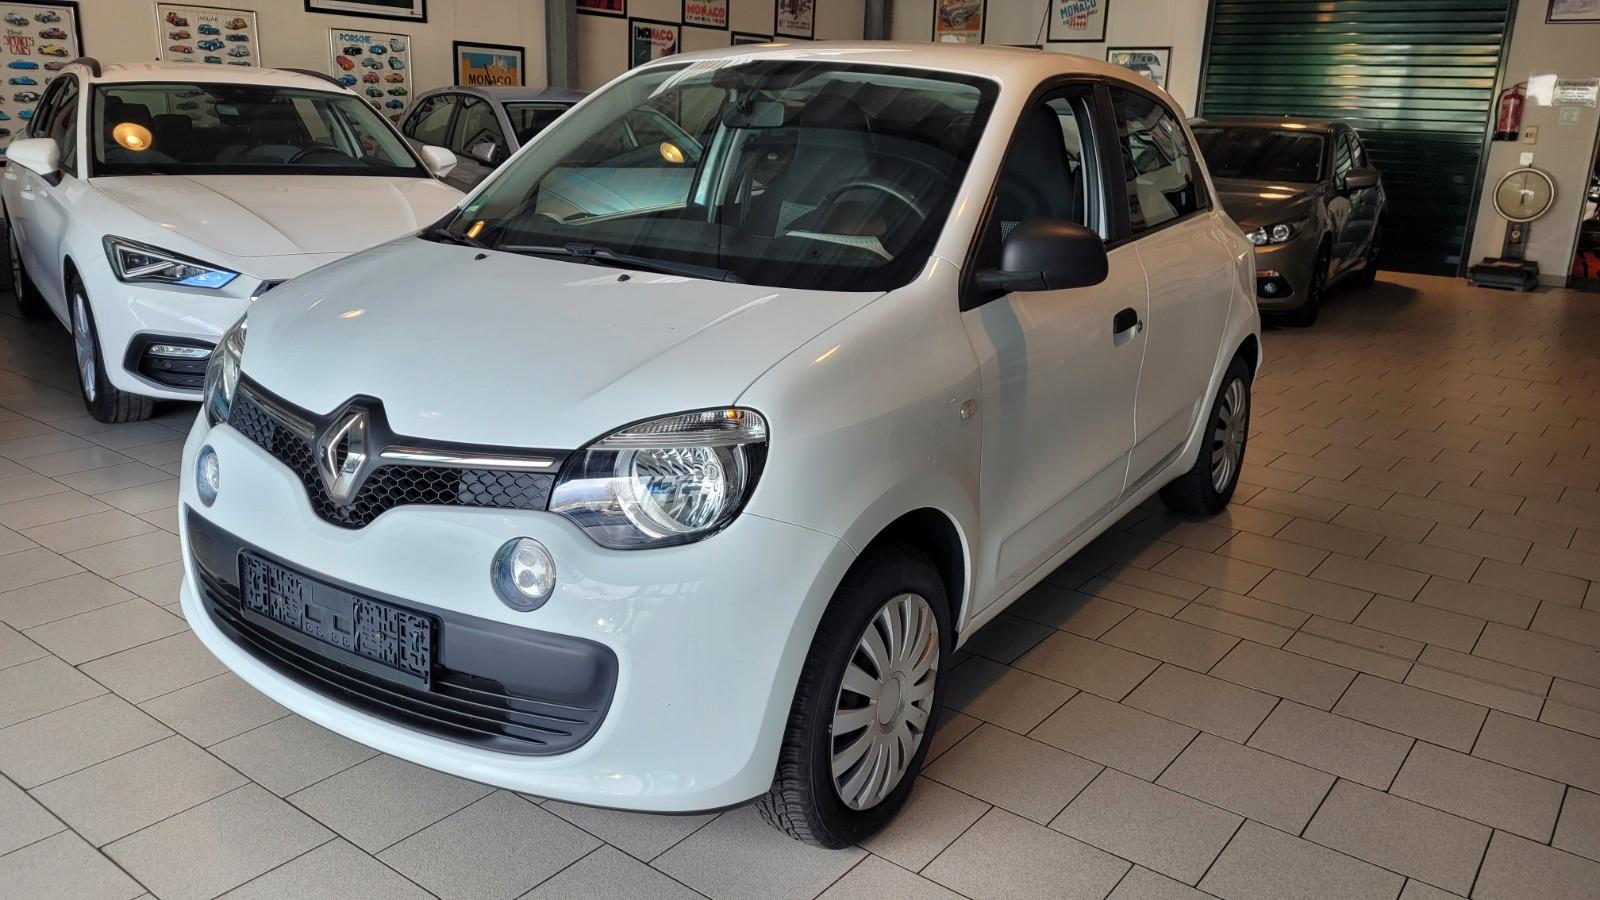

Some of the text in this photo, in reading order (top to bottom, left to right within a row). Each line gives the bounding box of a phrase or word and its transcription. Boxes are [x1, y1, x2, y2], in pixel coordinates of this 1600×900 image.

[687, 4, 725, 17] MONACO
[339, 32, 371, 44] PORSCHE
[637, 27, 673, 41] MONACO
[3, 35, 35, 47] SPORTS
[10, 45, 32, 56] CARS
[468, 73, 512, 86] MONACO
